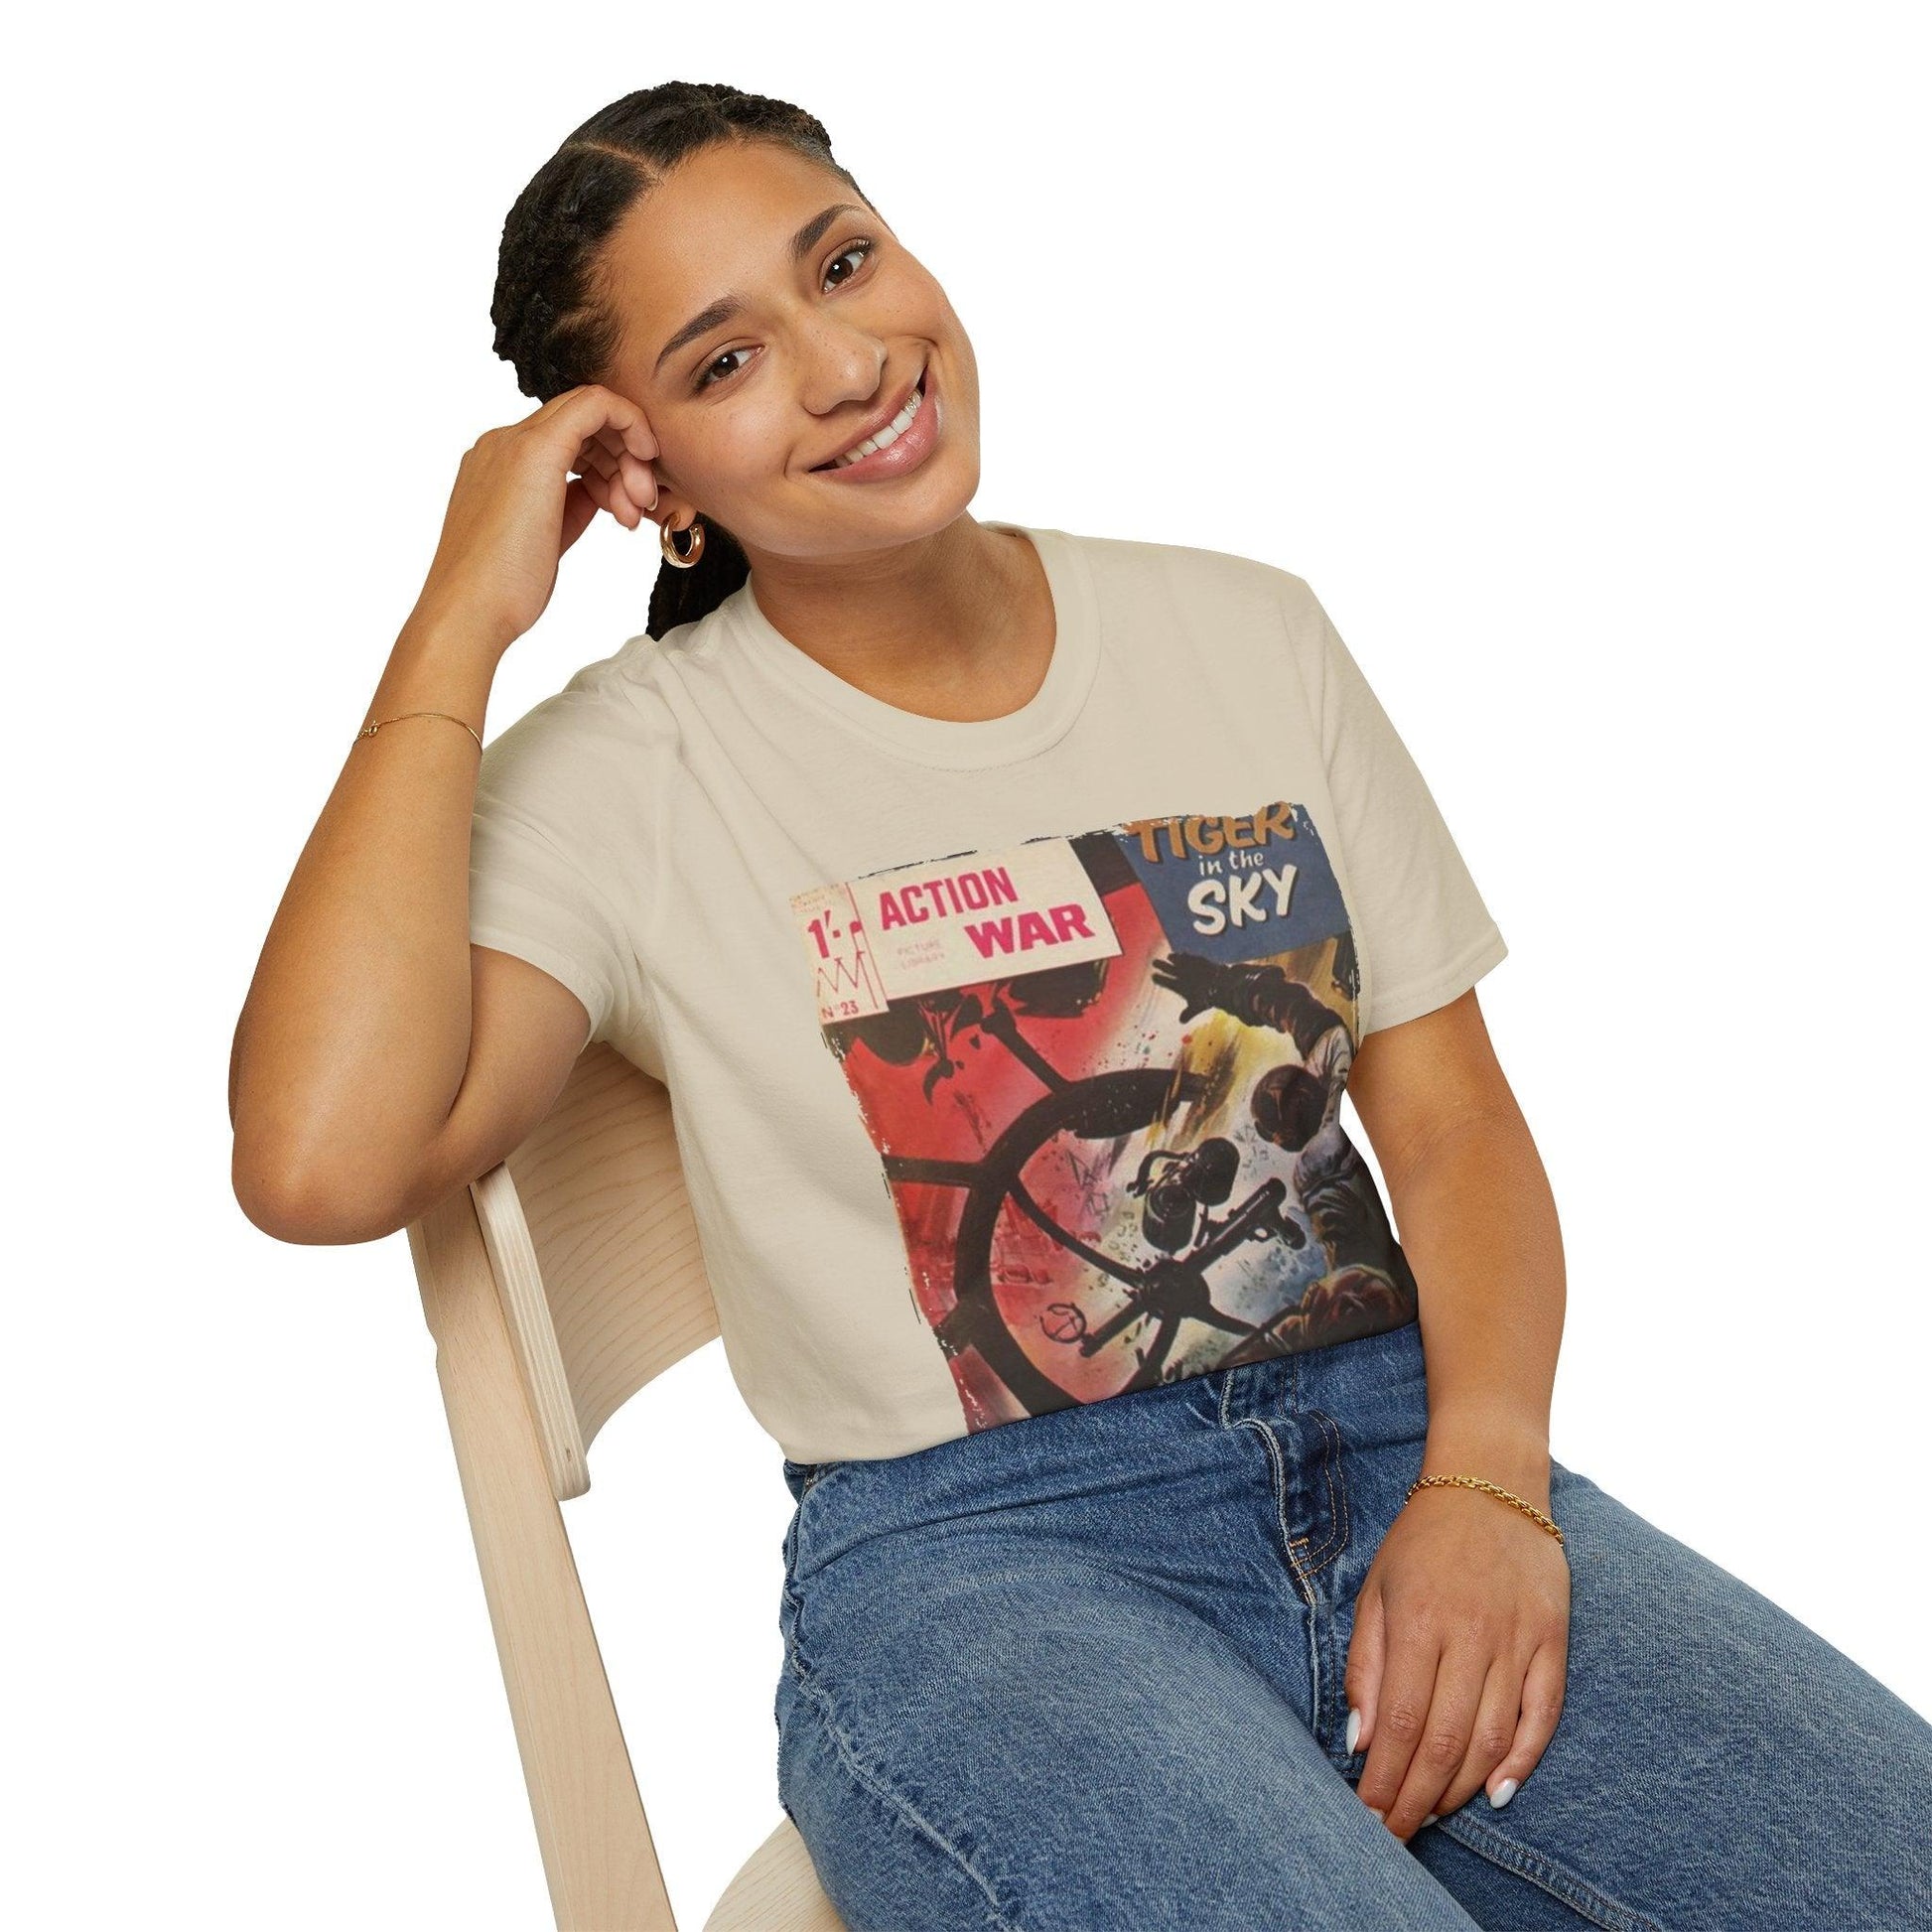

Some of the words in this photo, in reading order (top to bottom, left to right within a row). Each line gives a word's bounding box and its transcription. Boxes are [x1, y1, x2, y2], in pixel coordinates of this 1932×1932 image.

[1123, 801, 1295, 863] TIGER
[1198, 854, 1223, 876] in
[1228, 850, 1265, 870] the
[880, 866, 1020, 931] ACTION
[1187, 864, 1298, 936] SKY
[964, 903, 1095, 959] WAR
[840, 1000, 859, 1016] 23
